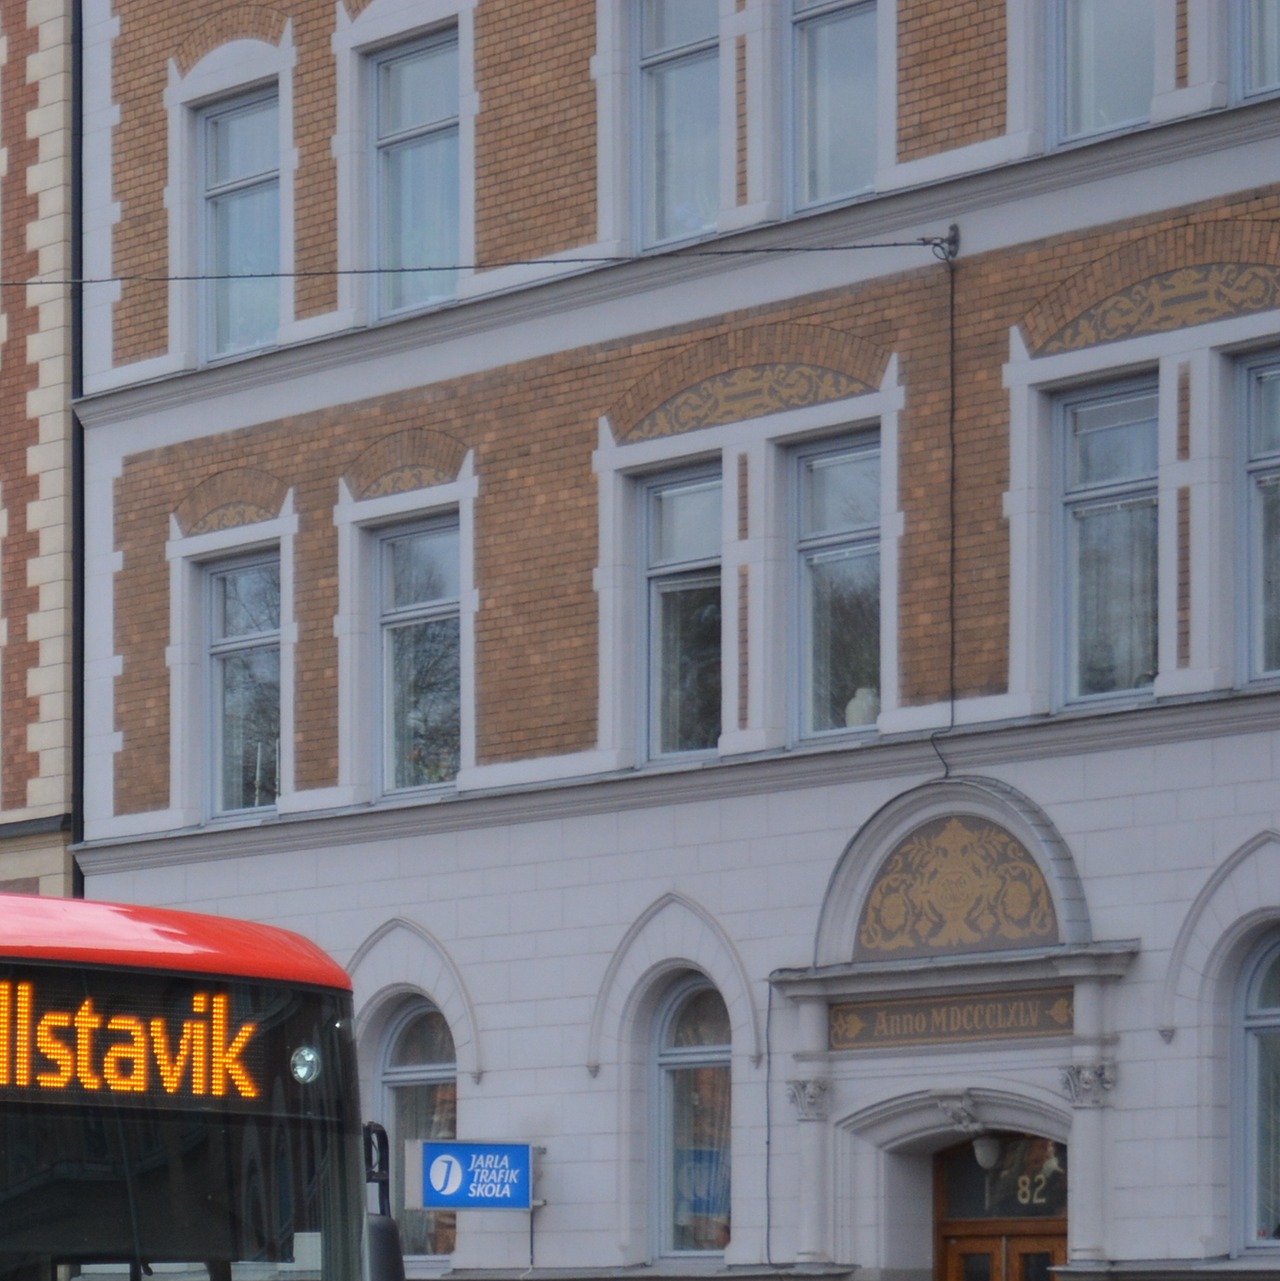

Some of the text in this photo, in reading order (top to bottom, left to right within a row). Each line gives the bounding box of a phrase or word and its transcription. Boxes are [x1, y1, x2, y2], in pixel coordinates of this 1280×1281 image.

[874, 1010, 926, 1037] Anno
[468, 1154, 509, 1171] JARLA
[473, 1169, 520, 1184] TRAFIK
[468, 1183, 511, 1198] SKOLA
[1017, 1174, 1046, 1204] 82
